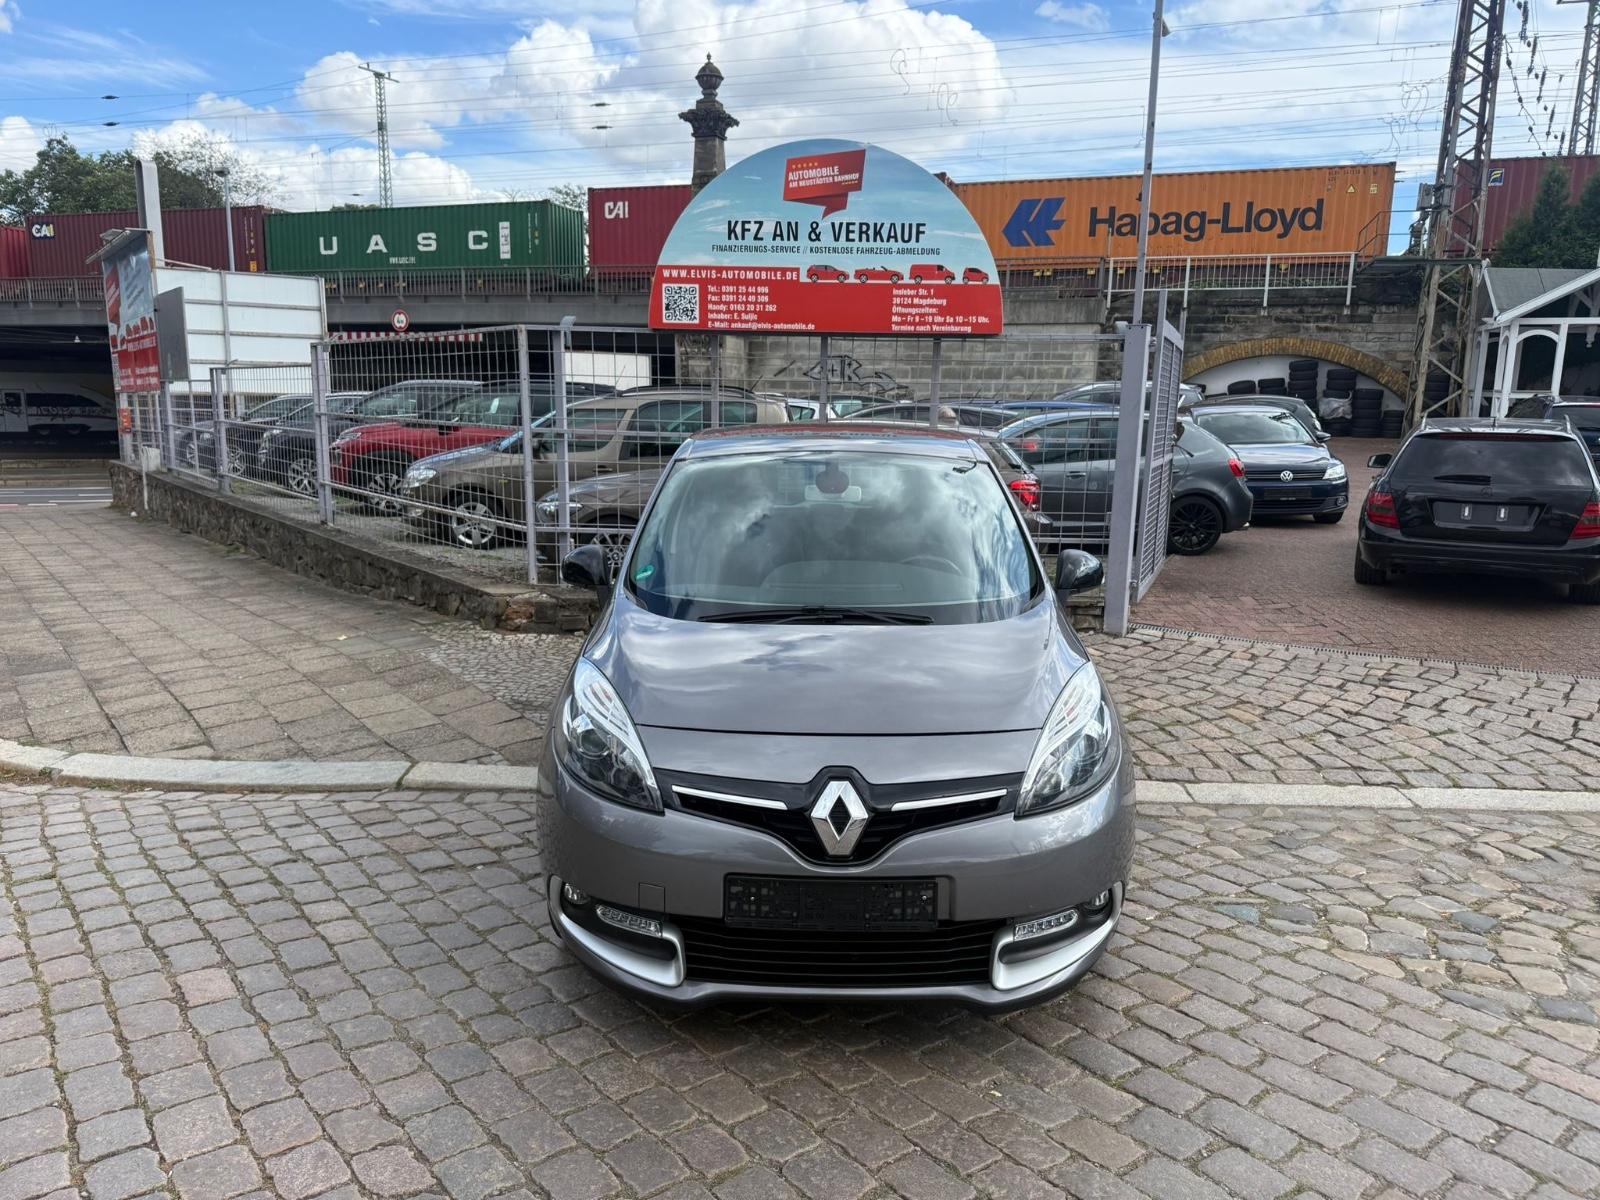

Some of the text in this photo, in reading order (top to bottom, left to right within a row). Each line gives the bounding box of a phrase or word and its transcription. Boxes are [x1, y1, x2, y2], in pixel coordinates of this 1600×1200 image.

[788, 166, 839, 180] AUTOMOBILE
[789, 180, 798, 188] AM
[834, 173, 860, 183] BAHNHOF
[604, 200, 629, 219] CAI
[1088, 198, 1324, 242] Hapag-Lloyd
[727, 220, 927, 244] KFZ AN & VERKAUF
[711, 244, 801, 254] FINANZIERUNGS-SERVICE
[809, 246, 854, 255] KOSTENLOSE
[856, 246, 941, 256] FAHRZEUG-ABMELDUNG
[662, 268, 798, 281] WWW.ELVIS-AUTOMOBILE.DE
[918, 288, 929, 296] Str.
[707, 303, 728, 312] Handy:
[892, 297, 947, 308] 39124 Magdeburg
[707, 312, 733, 320] Inhaber:
[892, 306, 939, 315] Öffnungszeiten:
[891, 324, 914, 332] Termine
[932, 325, 972, 333] Vereinbarung
